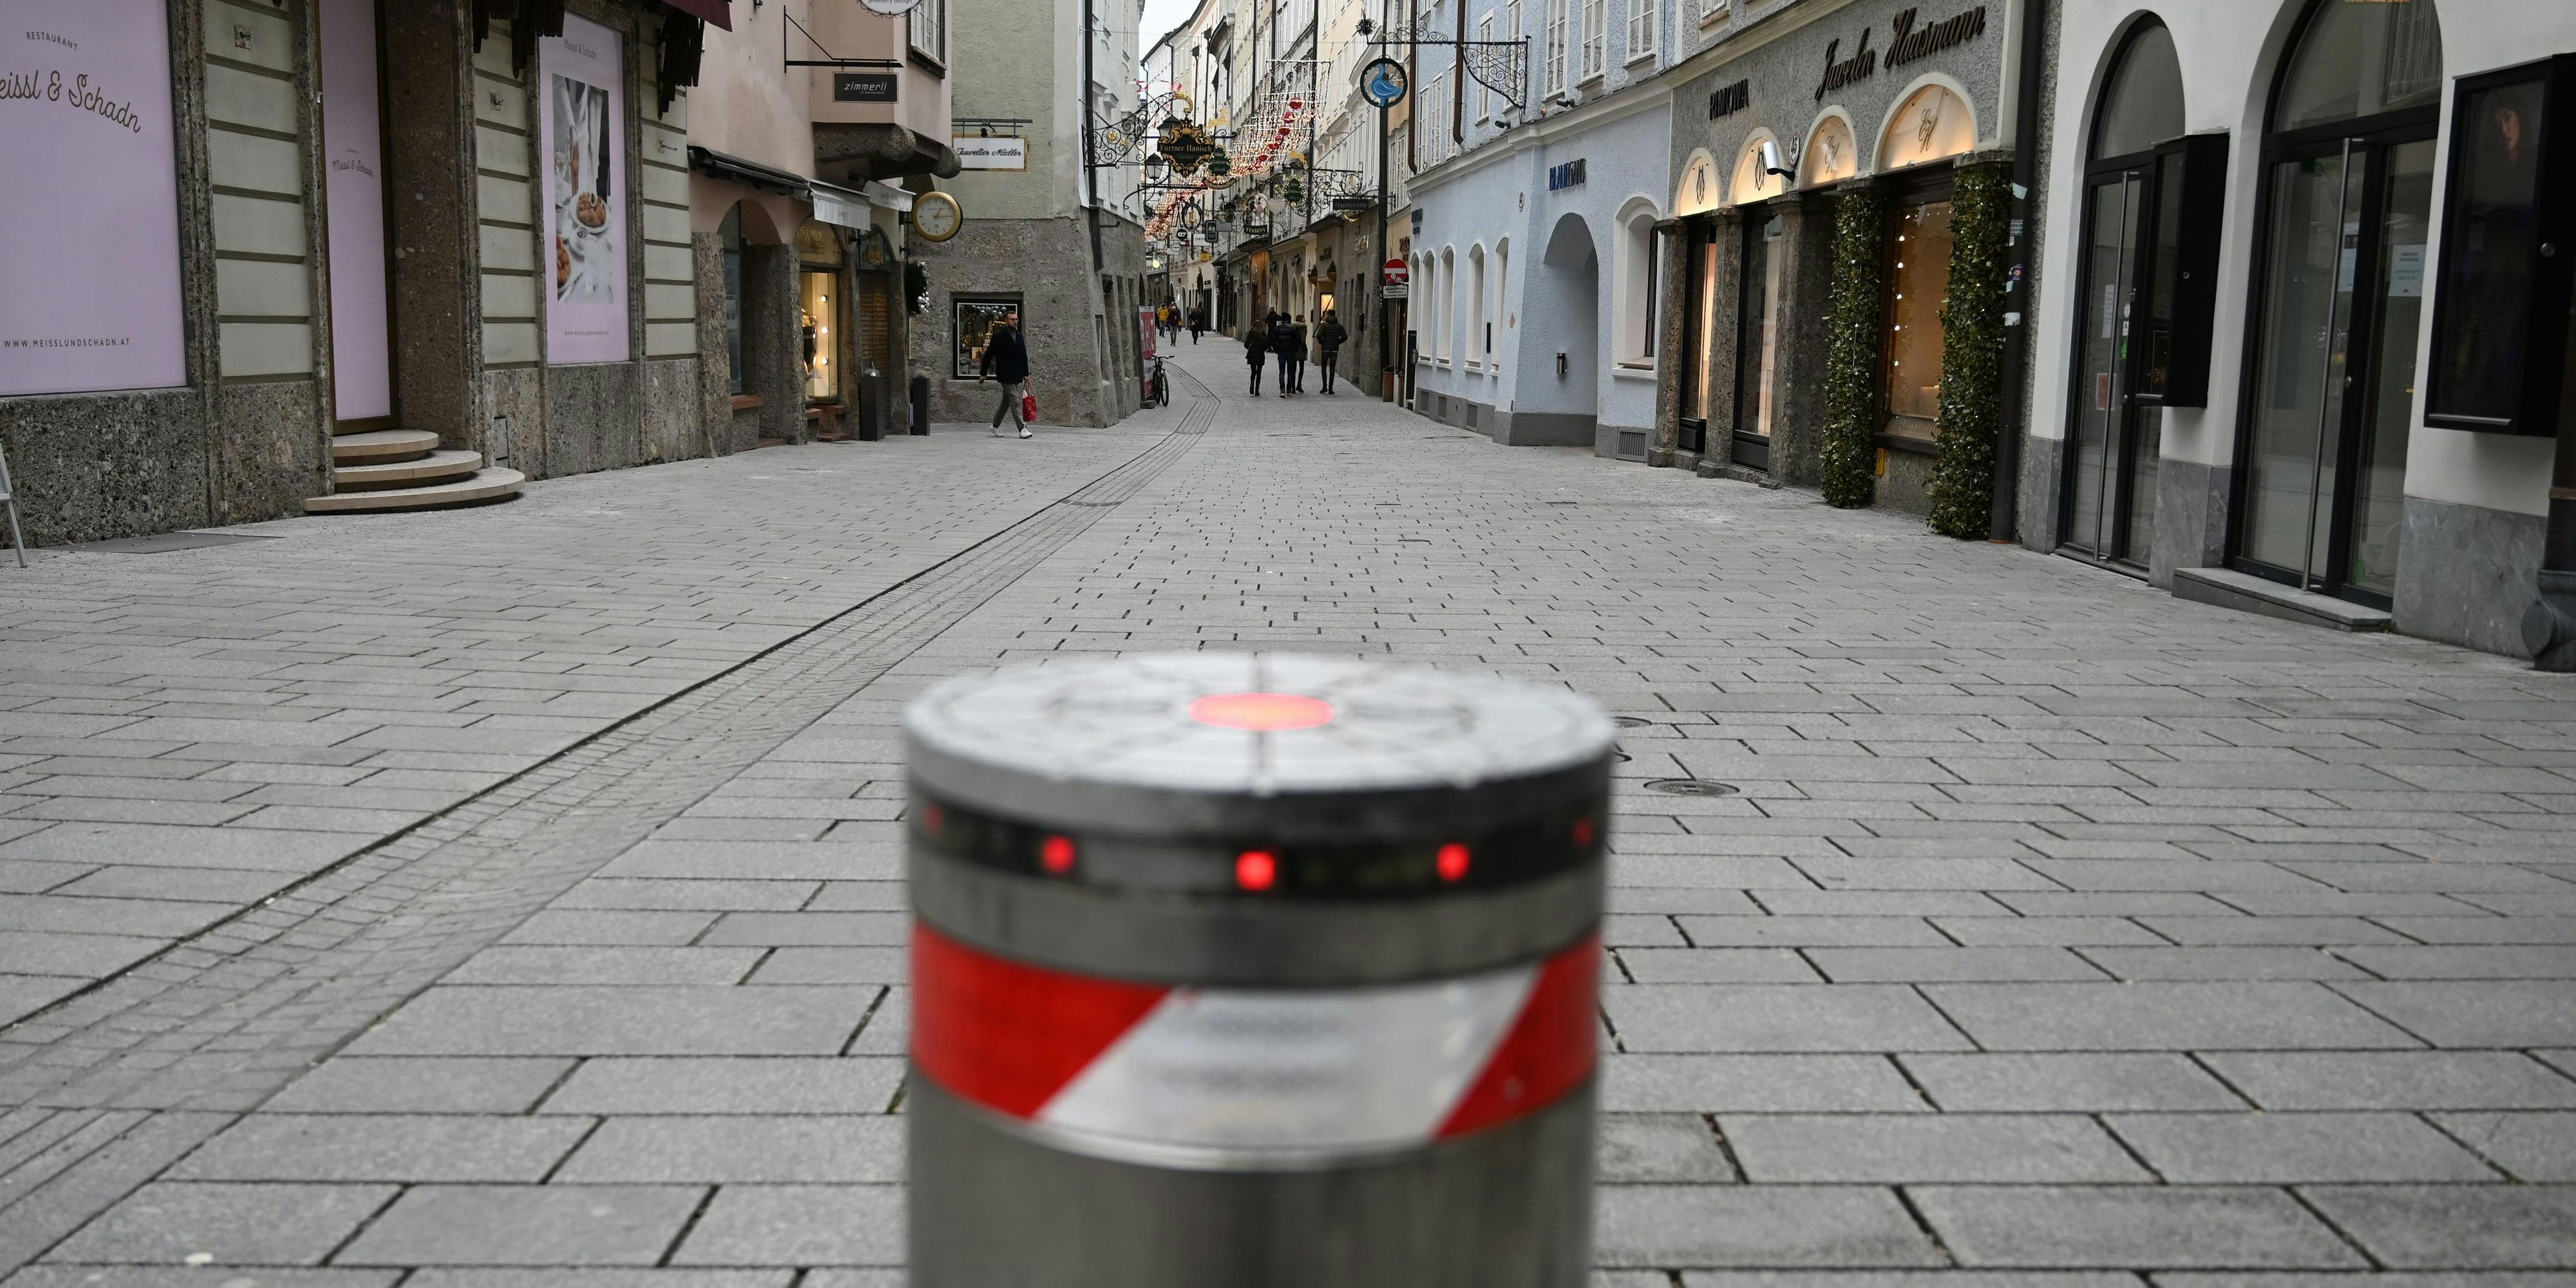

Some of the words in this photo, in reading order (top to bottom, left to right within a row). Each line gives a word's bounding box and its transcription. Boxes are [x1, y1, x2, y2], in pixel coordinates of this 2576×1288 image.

[26, 32, 78, 51] RESTAURANT
[844, 81, 887, 91] zimmerli
[0, 70, 41, 99] eissl
[48, 70, 62, 101] &
[68, 73, 141, 133] Schadn
[1710, 79, 1749, 121] RIMOWA
[956, 147, 990, 156] Juwelier
[4, 338, 129, 348] WWW.MEISSLUNDSCHADN.AT
